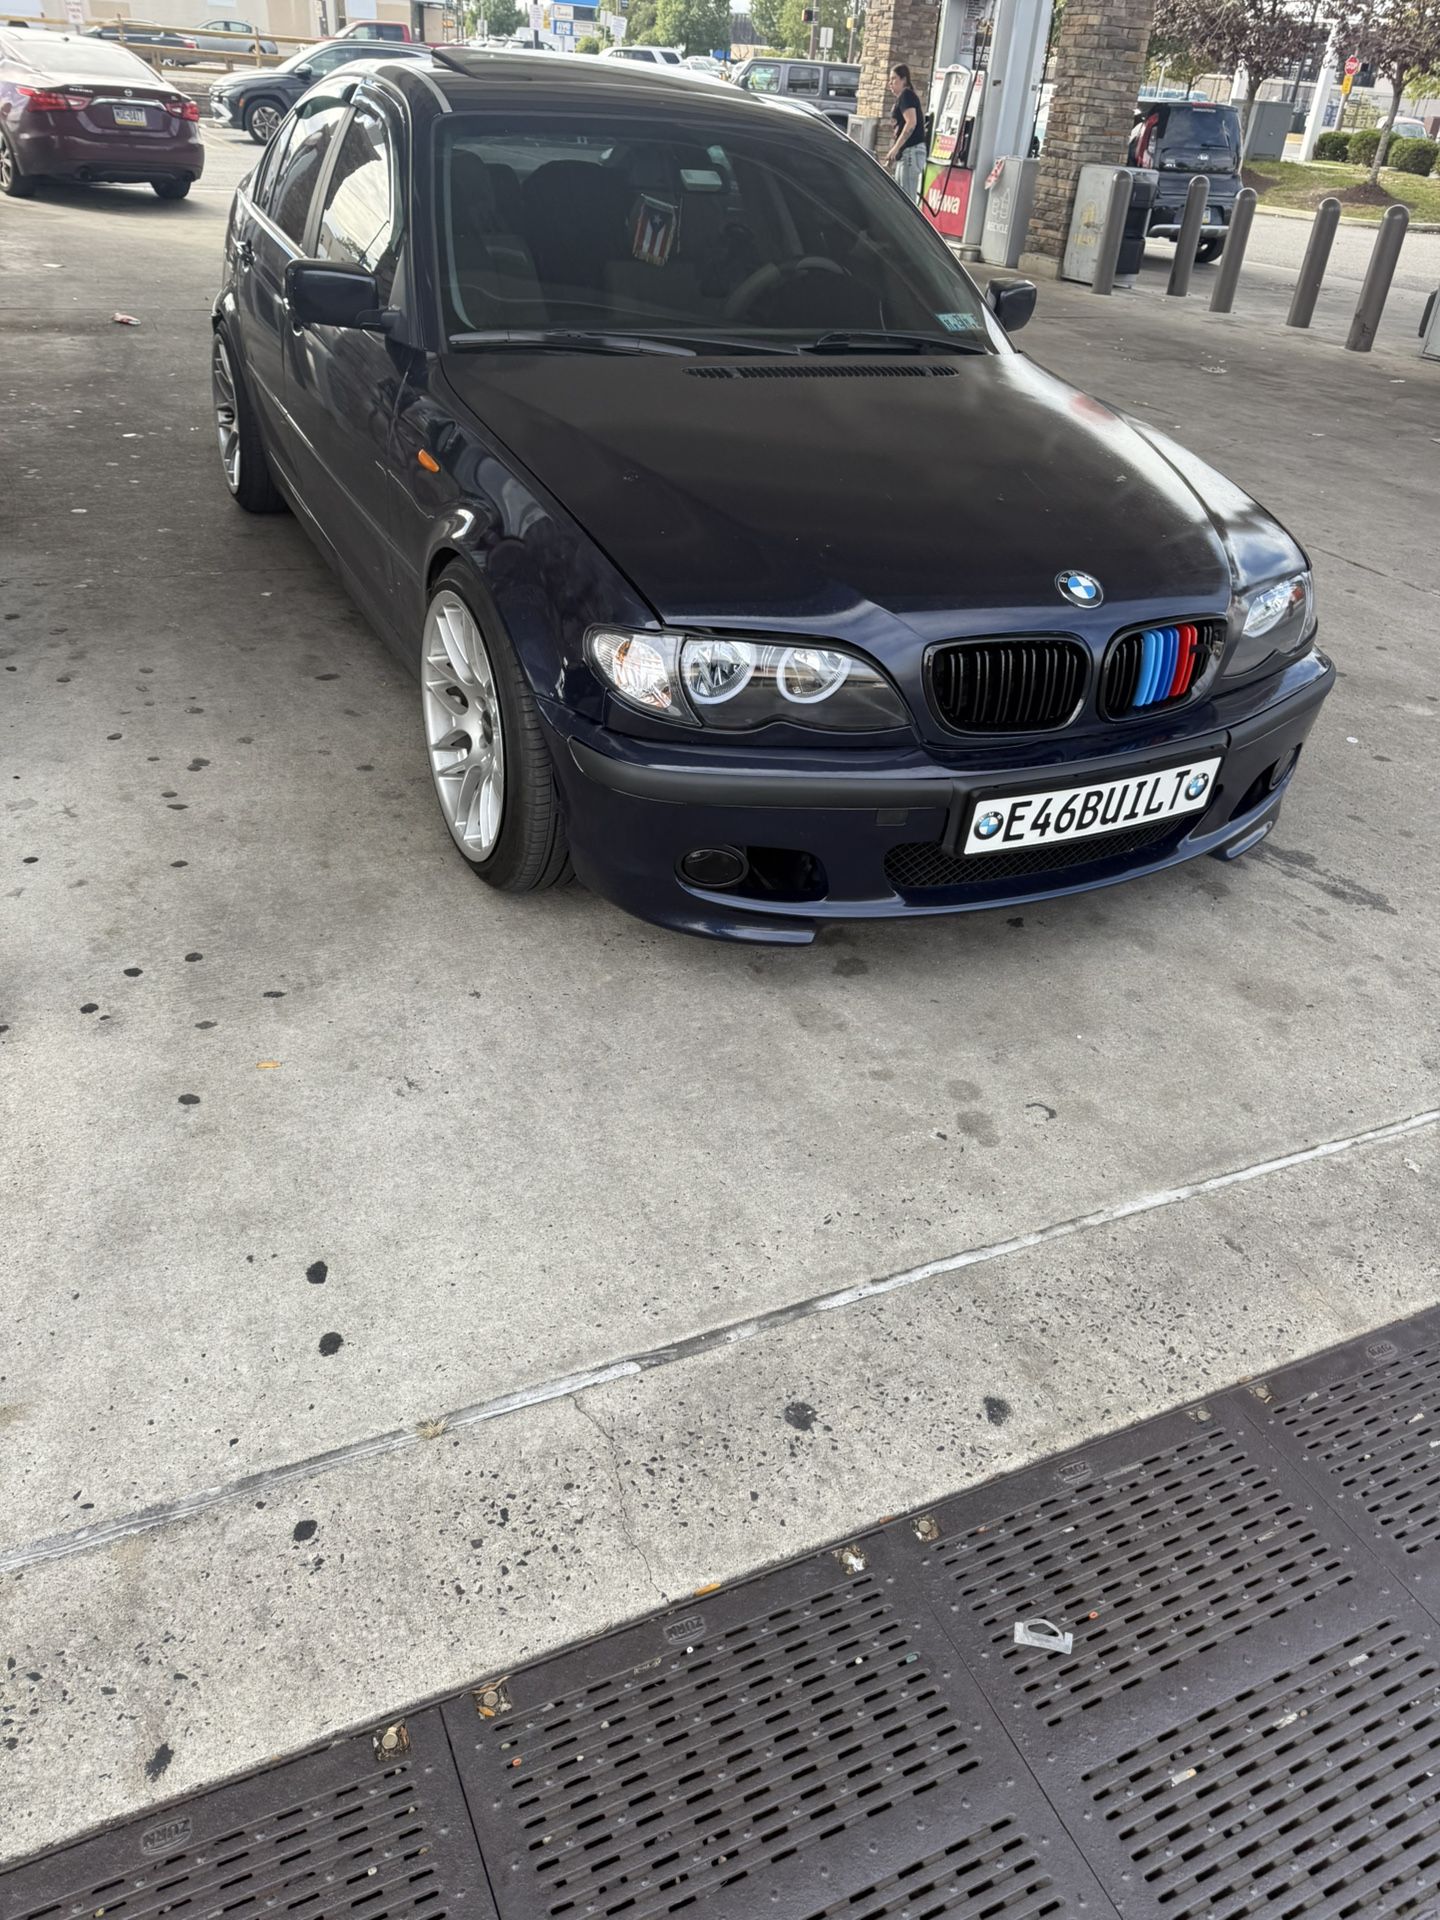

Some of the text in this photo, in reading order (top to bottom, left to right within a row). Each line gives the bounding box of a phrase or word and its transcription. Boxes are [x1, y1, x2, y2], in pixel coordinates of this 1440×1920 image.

[986, 221, 1008, 234] RECYCLE
[1002, 769, 1192, 842] E46BUILT
[667, 1617, 703, 1638] ZURN
[142, 1819, 191, 1849] ZURN
